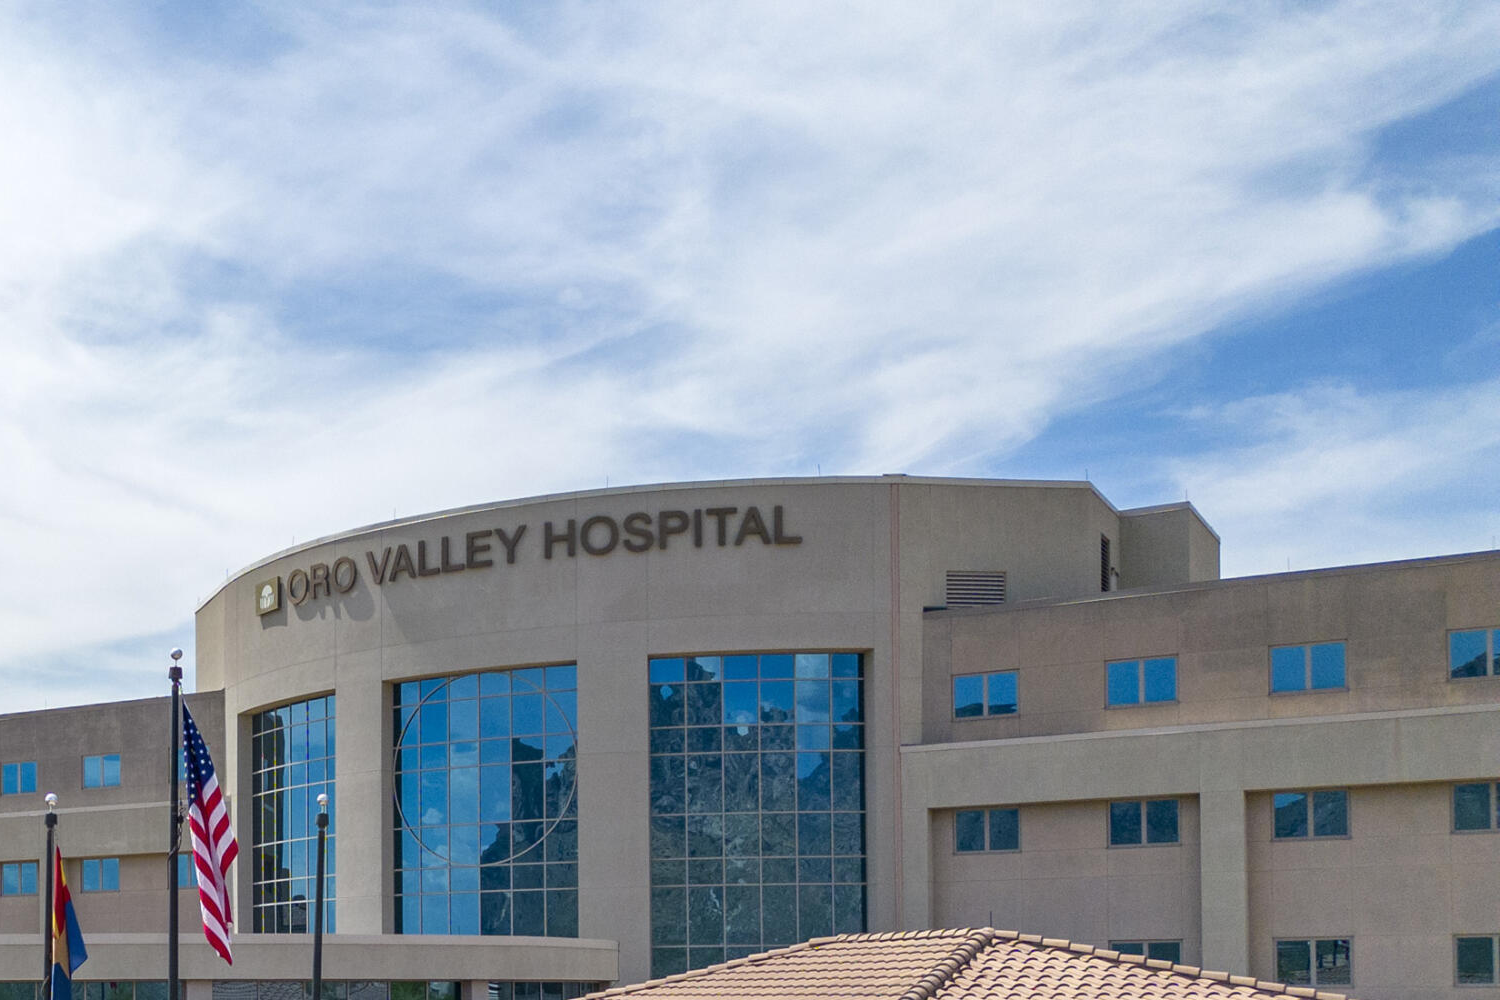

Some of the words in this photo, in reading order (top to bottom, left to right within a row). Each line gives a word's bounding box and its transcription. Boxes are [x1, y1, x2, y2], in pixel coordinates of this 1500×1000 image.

[286, 556, 357, 606] ORO
[366, 525, 527, 585] VALLEY
[544, 505, 803, 559] HOSPITAL
